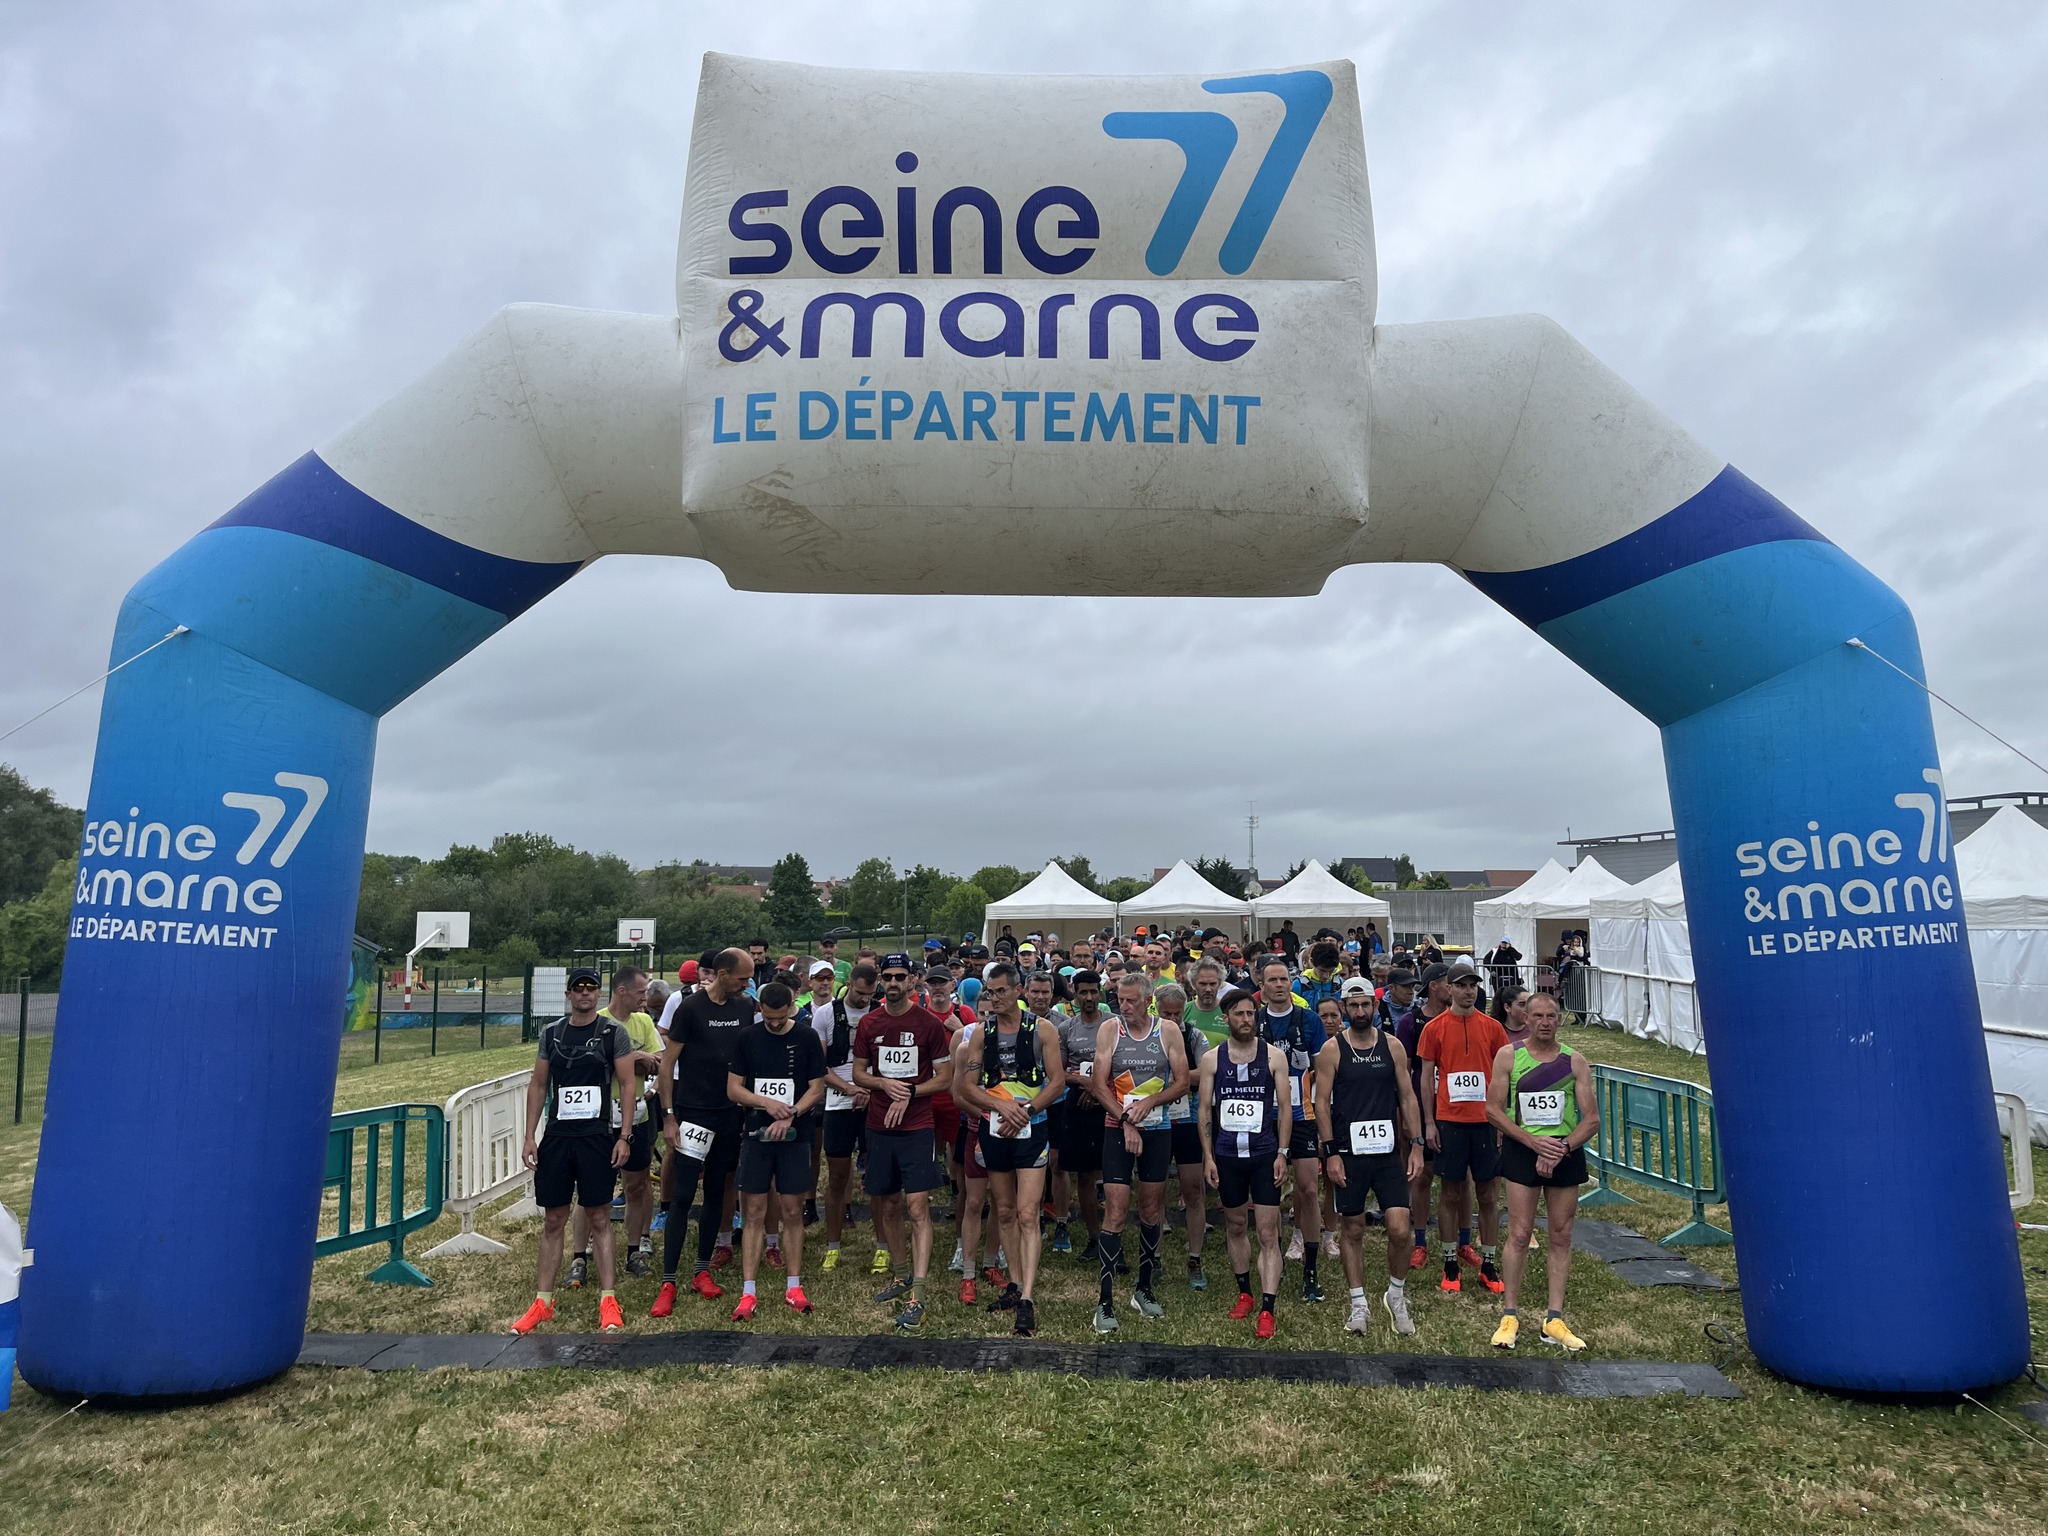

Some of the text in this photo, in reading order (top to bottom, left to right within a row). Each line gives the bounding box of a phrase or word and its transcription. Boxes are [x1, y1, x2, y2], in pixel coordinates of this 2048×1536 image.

[728, 151, 1100, 274] seine
[718, 289, 1259, 362] &marne
[713, 376, 1261, 445] LE DÉPARTEMENT
[83, 806, 216, 861] seine
[1735, 820, 1902, 877] seine
[76, 866, 282, 915] &marne
[1744, 874, 1953, 924] &marne
[71, 912, 278, 948] LE DÉPARTEMENT
[1748, 922, 1960, 956] LE DÉPARTEMENT
[884, 1050, 911, 1064] 402
[1352, 1055, 1381, 1063] KIPRUN
[760, 1082, 787, 1096] 456
[1454, 1075, 1479, 1088] 480
[564, 1090, 591, 1104] 521
[1221, 1086, 1266, 1095] LA MEUTE
[1227, 1103, 1254, 1117] 463
[1528, 1096, 1558, 1109] 453
[685, 1128, 709, 1145] 444
[1359, 1125, 1387, 1139] 415
